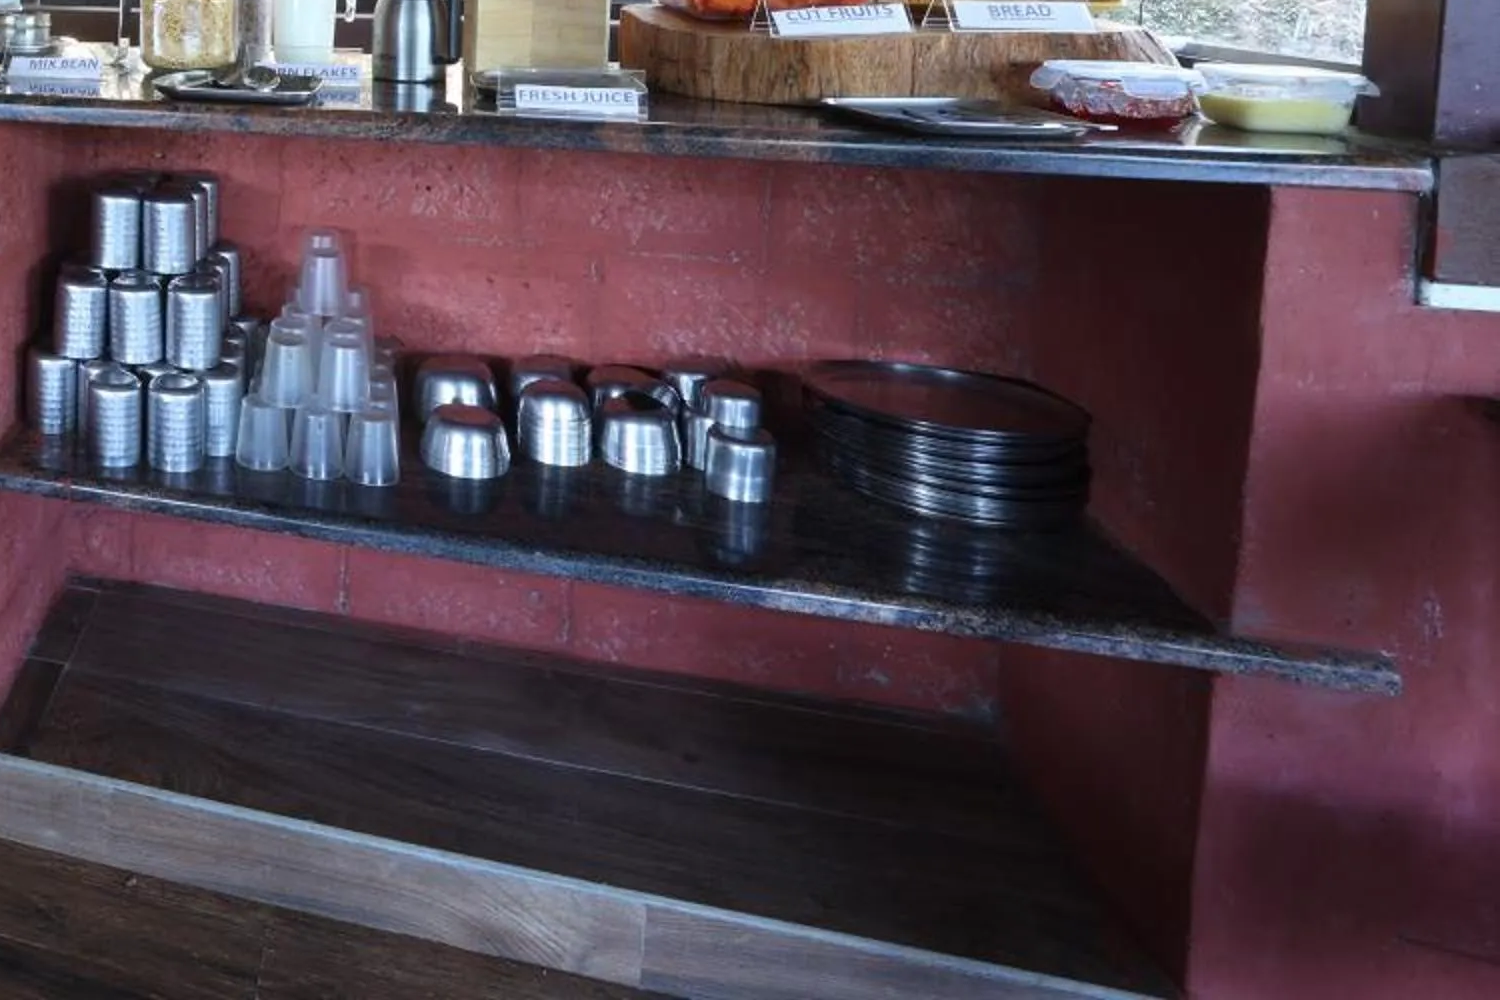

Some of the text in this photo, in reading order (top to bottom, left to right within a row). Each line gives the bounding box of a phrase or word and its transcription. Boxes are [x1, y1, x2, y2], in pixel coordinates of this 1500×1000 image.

[786, 5, 894, 21] CUT FRUITS
[988, 4, 1052, 17] BREAD
[519, 89, 634, 103] FRESH JUICE
